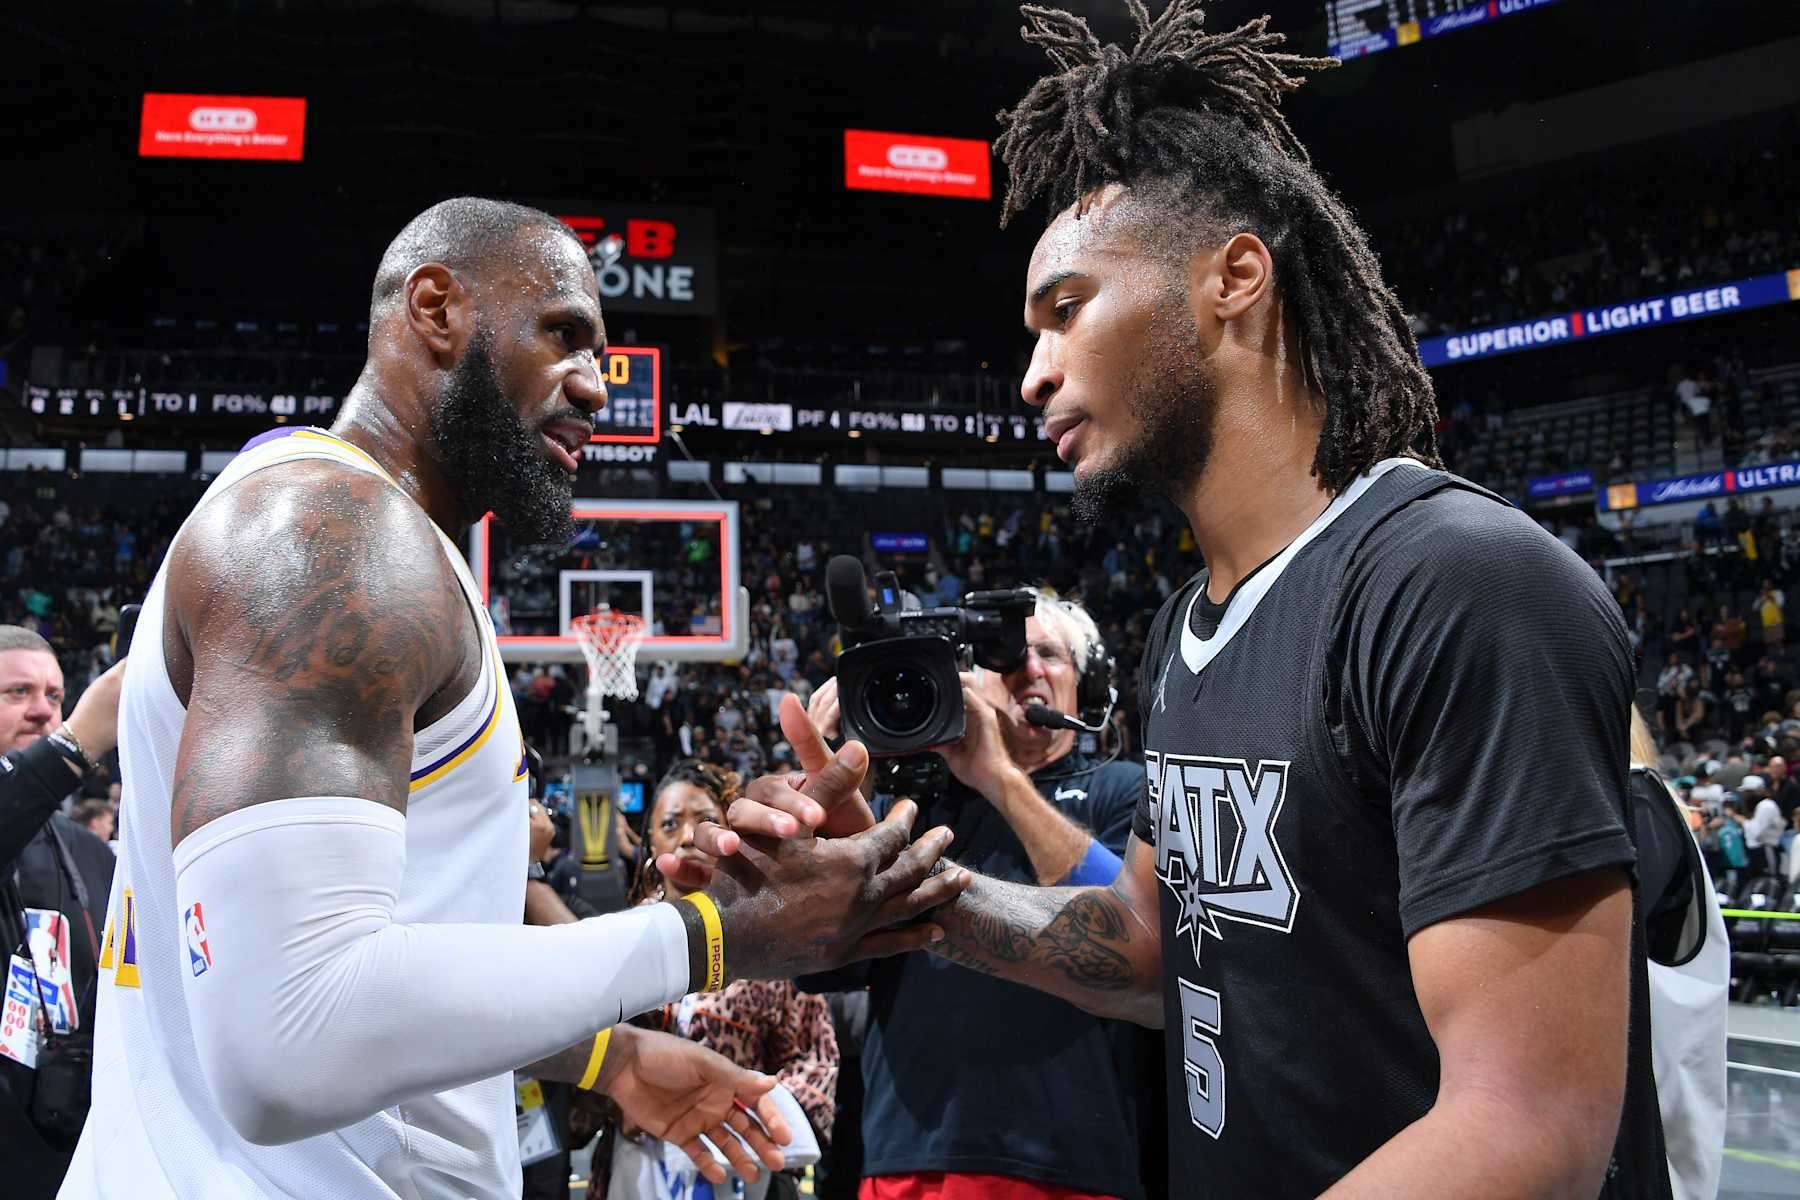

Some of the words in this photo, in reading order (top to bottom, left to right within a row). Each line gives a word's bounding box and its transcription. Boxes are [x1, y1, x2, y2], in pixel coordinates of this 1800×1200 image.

[1587, 300, 1665, 333] LIGHT
[1670, 286, 1741, 318] BEER
[1446, 318, 1569, 358] SUPERIOR
[151, 393, 183, 412] TO
[303, 396, 335, 414] PF
[669, 402, 719, 426] LAL
[797, 409, 825, 428] PF
[930, 414, 959, 432] TO
[582, 445, 657, 462] TISSOT
[1178, 976, 1227, 1141] 5
